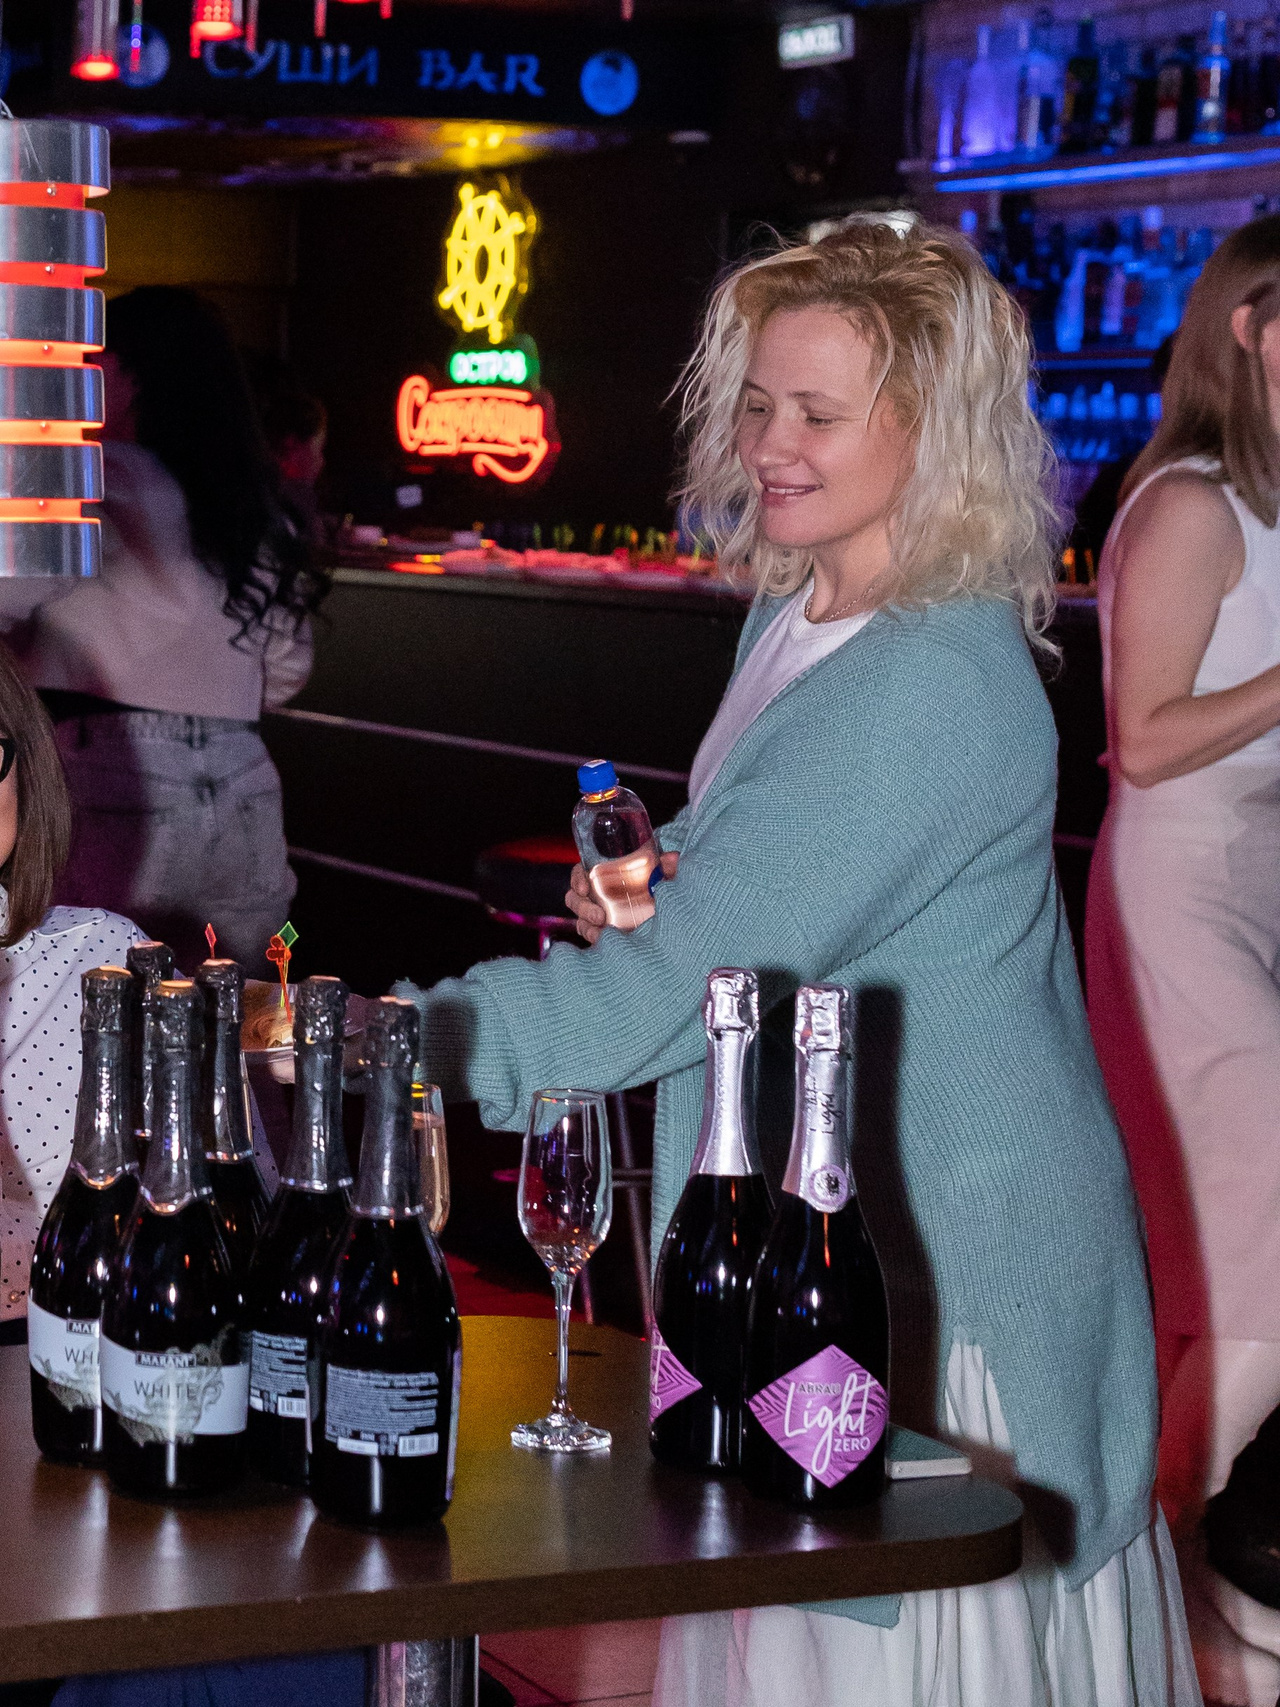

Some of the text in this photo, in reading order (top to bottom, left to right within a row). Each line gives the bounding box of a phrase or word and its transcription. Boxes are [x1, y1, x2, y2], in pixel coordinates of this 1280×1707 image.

[419, 48, 546, 98] BAR
[65, 1345, 100, 1365] WHI
[140, 1354, 190, 1368] MARANI
[134, 1380, 197, 1400] WHITE
[798, 1381, 841, 1396] ABRAU
[784, 1372, 878, 1475] Light
[833, 1437, 871, 1453] ZERO
